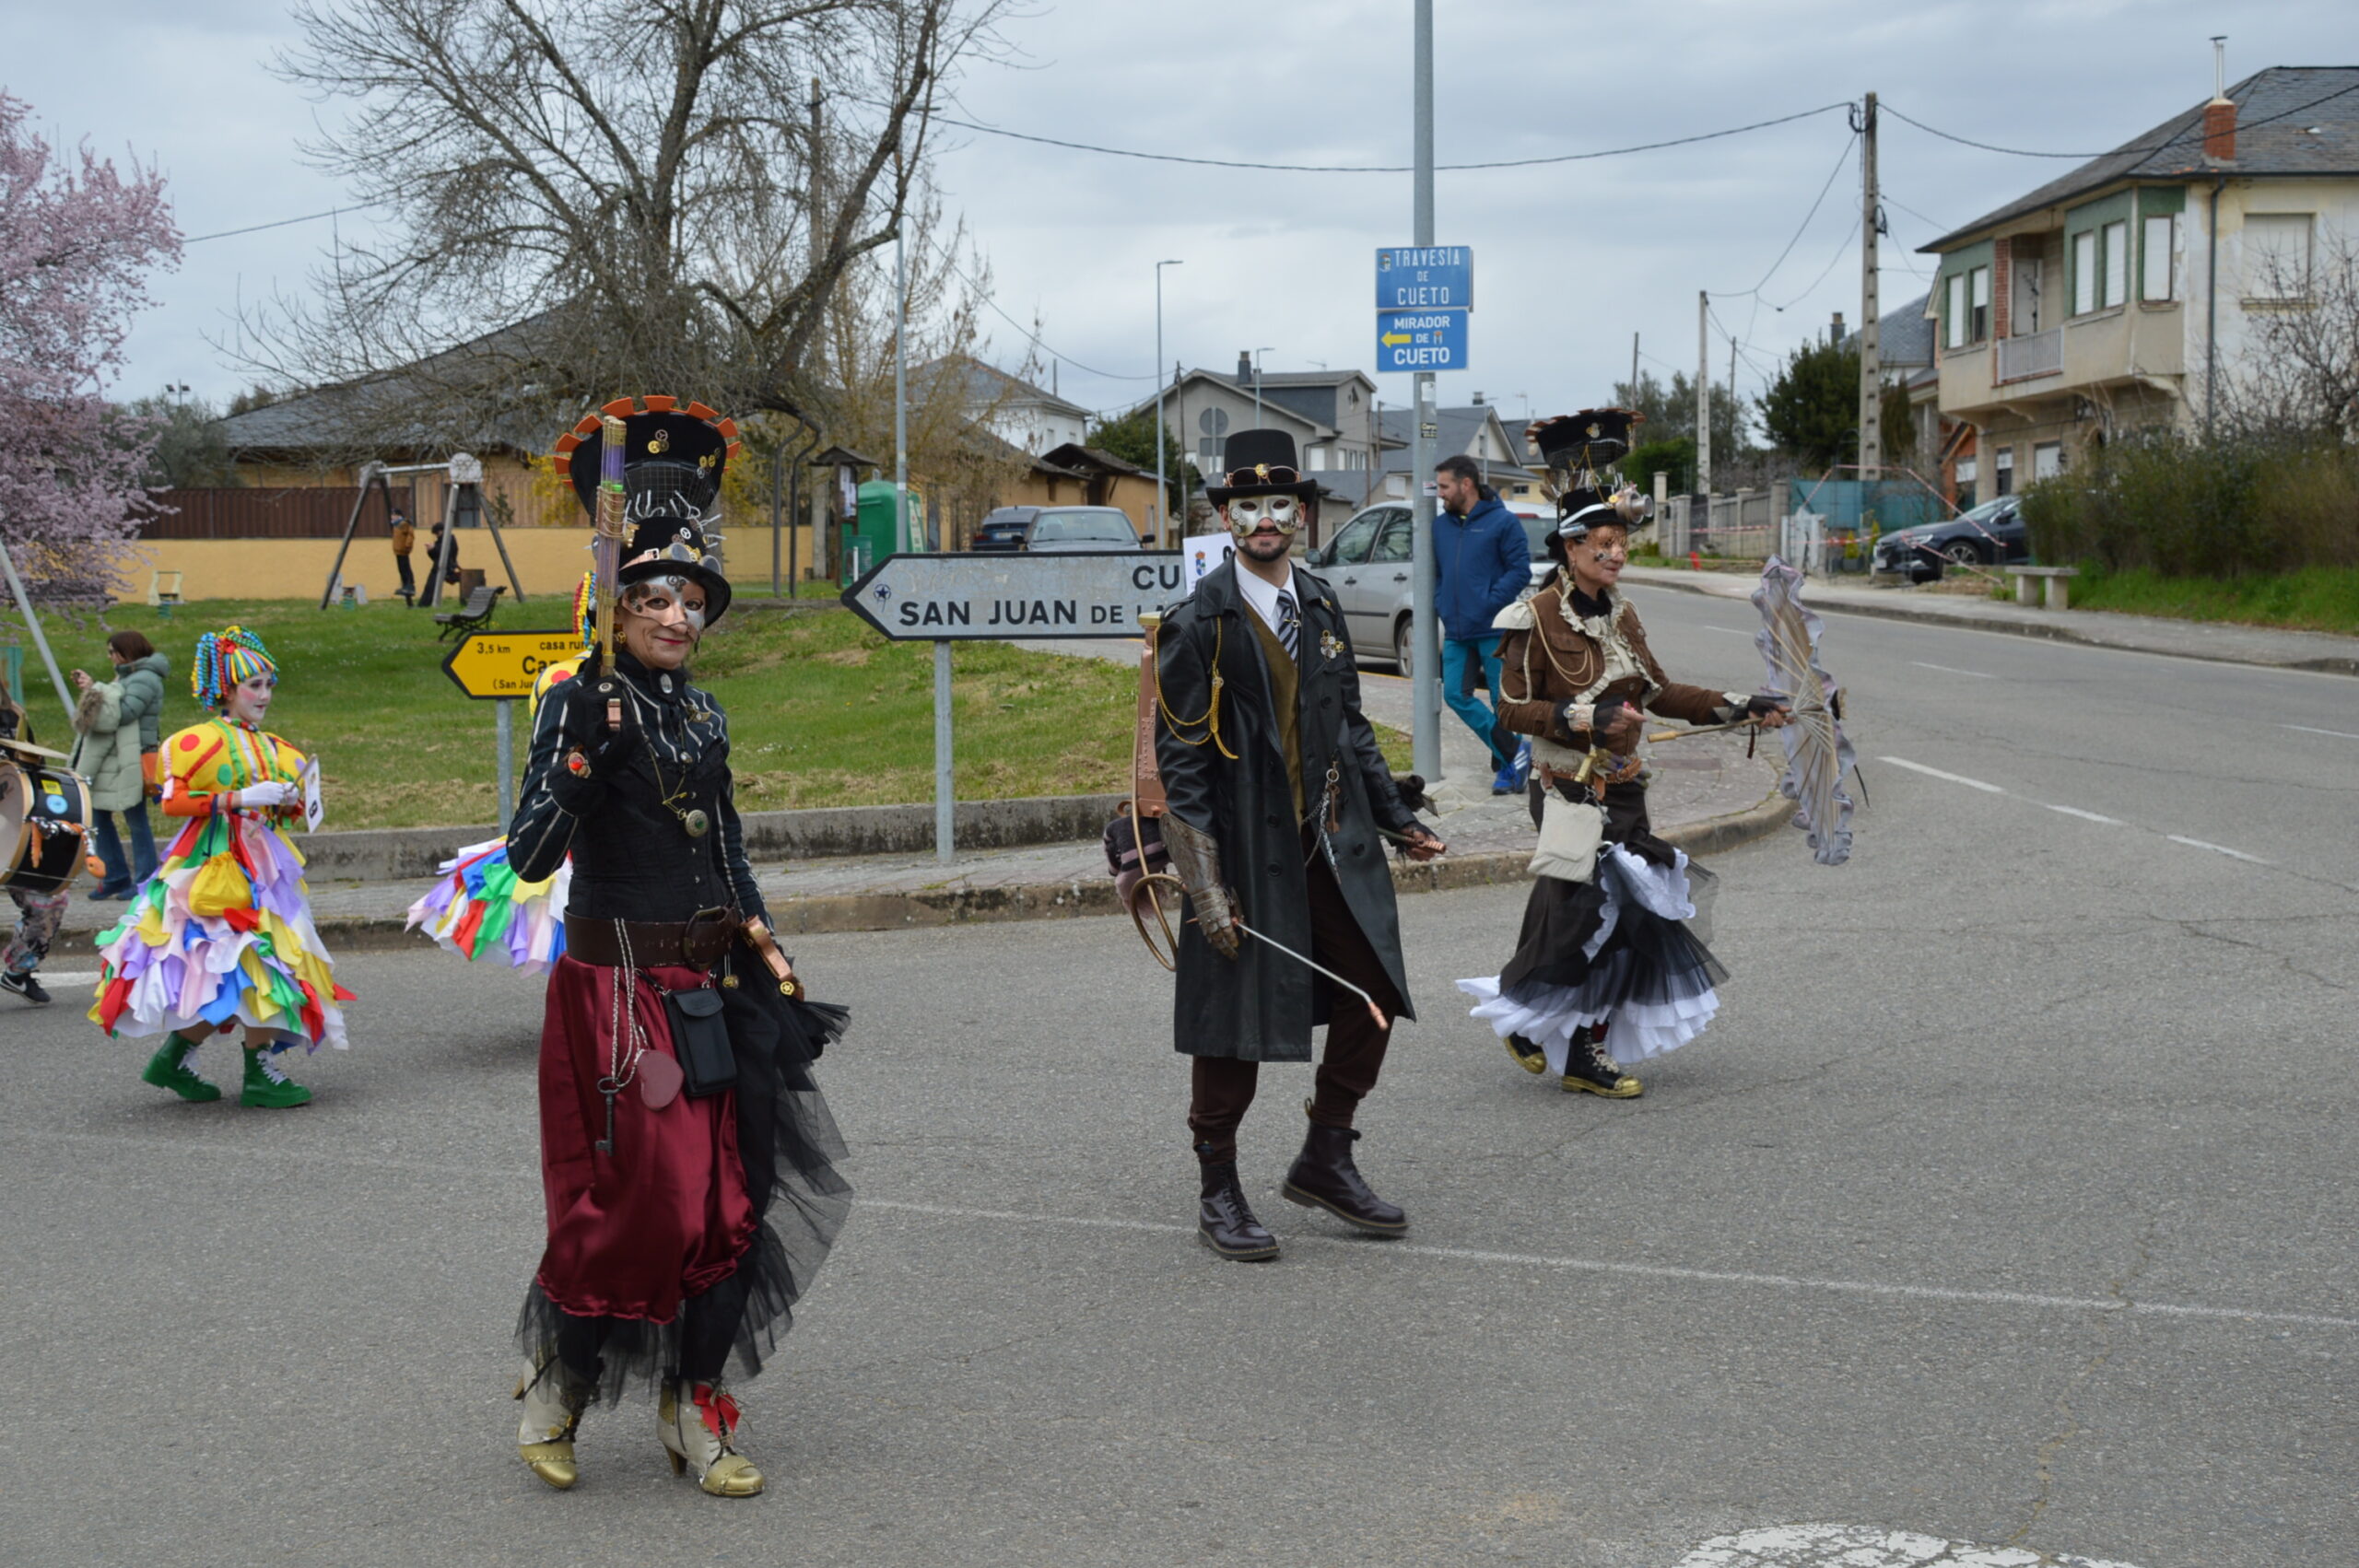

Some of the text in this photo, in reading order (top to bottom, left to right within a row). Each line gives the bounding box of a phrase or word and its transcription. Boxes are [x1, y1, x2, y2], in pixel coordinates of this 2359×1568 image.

[1395, 248, 1460, 267] TRAVESÍA
[1417, 271, 1429, 282] DE
[1398, 287, 1449, 306] CUETO
[1394, 316, 1450, 330] MIRADOR
[1416, 333, 1429, 344] DE
[1394, 347, 1450, 365] CUETO
[1133, 564, 1182, 591] CU
[898, 601, 970, 626] SAN
[988, 600, 1076, 625] JUAN
[1091, 605, 1123, 624] DE
[497, 644, 511, 653] km
[539, 641, 565, 650] casa
[522, 655, 559, 675] Ca
